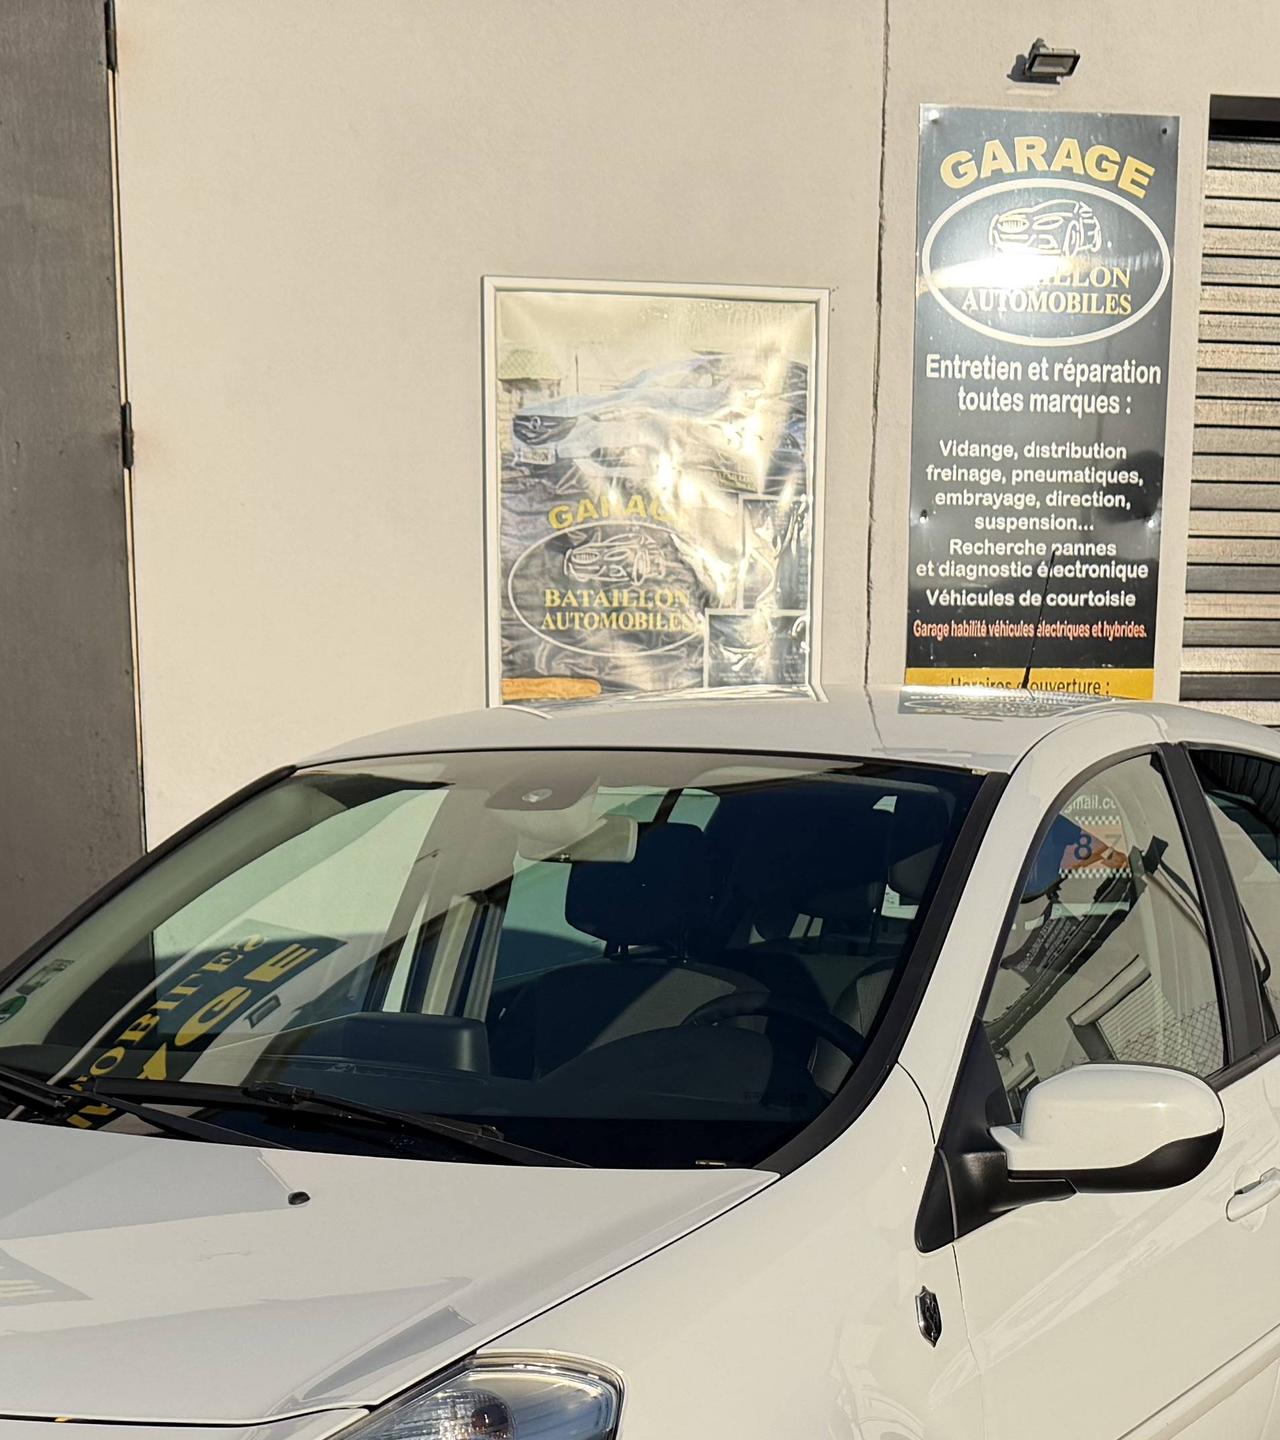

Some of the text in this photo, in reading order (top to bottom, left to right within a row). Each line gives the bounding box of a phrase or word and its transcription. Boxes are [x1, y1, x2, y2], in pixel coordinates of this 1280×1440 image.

[939, 136, 1155, 199] GARAGE
[961, 287, 1132, 315] AUTOMOBILES
[926, 354, 1161, 388] Entretien et réparation
[958, 386, 1132, 419] toutes marques :
[939, 440, 1127, 461] Vidange, distribution
[926, 464, 1144, 487] freinage, pneumatiques,
[935, 489, 1131, 510] embrayage, direction,
[974, 514, 1094, 533] suspension...
[950, 538, 1117, 558] Recherche pannes
[916, 561, 935, 577] et
[938, 560, 1033, 581] diagnostic
[544, 588, 690, 608] BATAILLON
[926, 589, 1136, 607] Véhicules de courtoisie
[540, 612, 698, 632] AUTOMOBILES
[913, 619, 1147, 642] Garage habilité véhicules électriques et hybrides.
